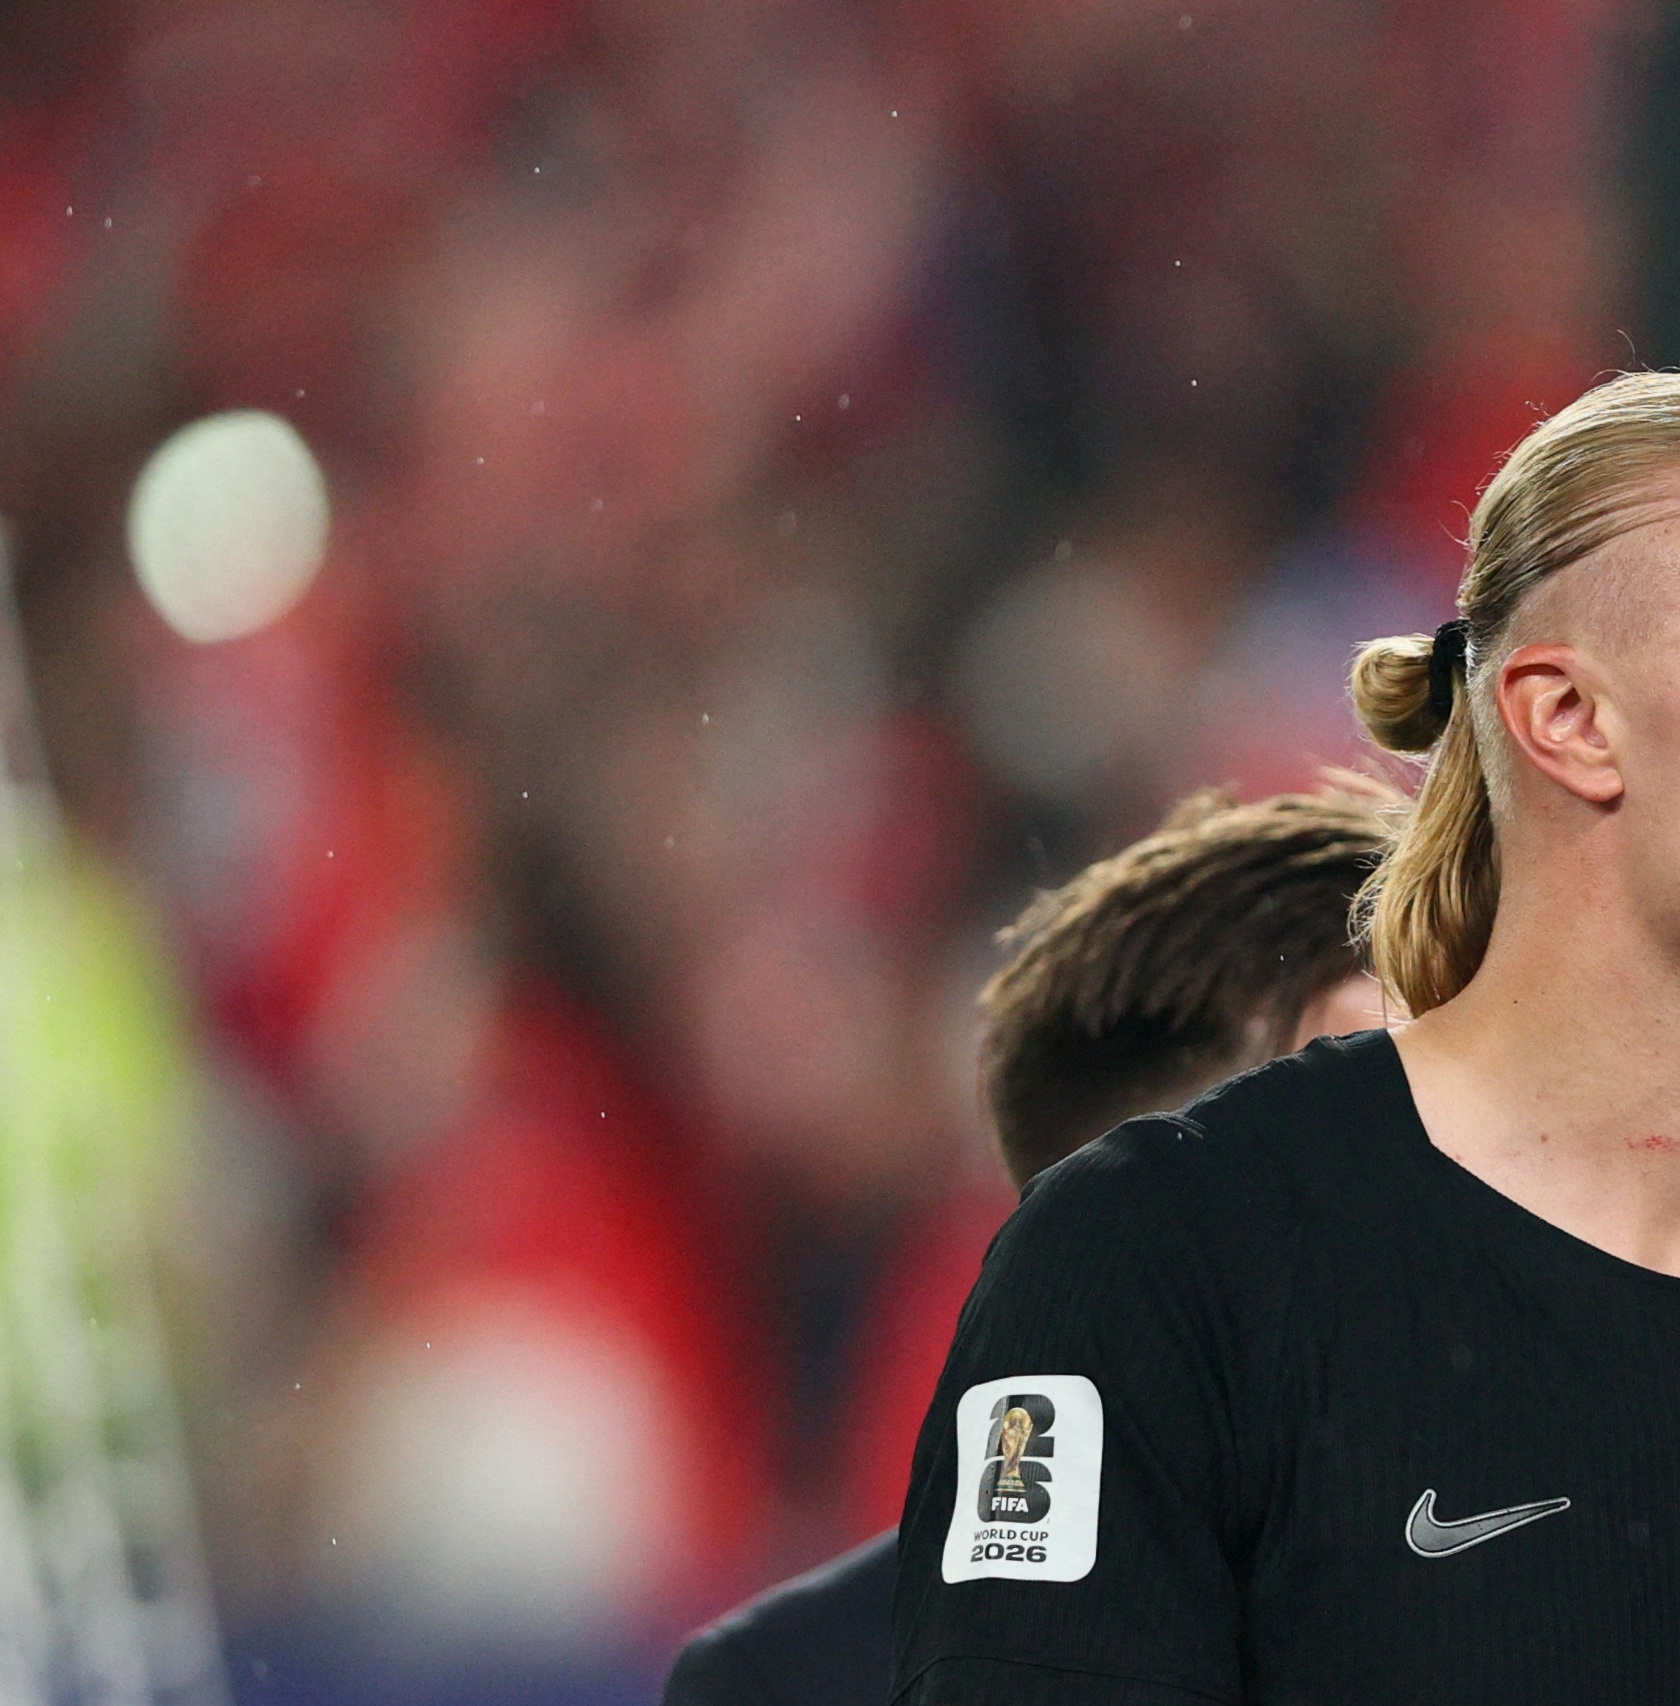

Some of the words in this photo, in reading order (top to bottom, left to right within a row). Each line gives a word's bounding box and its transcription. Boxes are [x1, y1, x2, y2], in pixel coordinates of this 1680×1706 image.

[991, 1496, 1029, 1513] FIFA
[974, 1528, 1017, 1541] WORLD
[1020, 1530, 1049, 1541] CUP
[970, 1542, 1047, 1563] 2026
